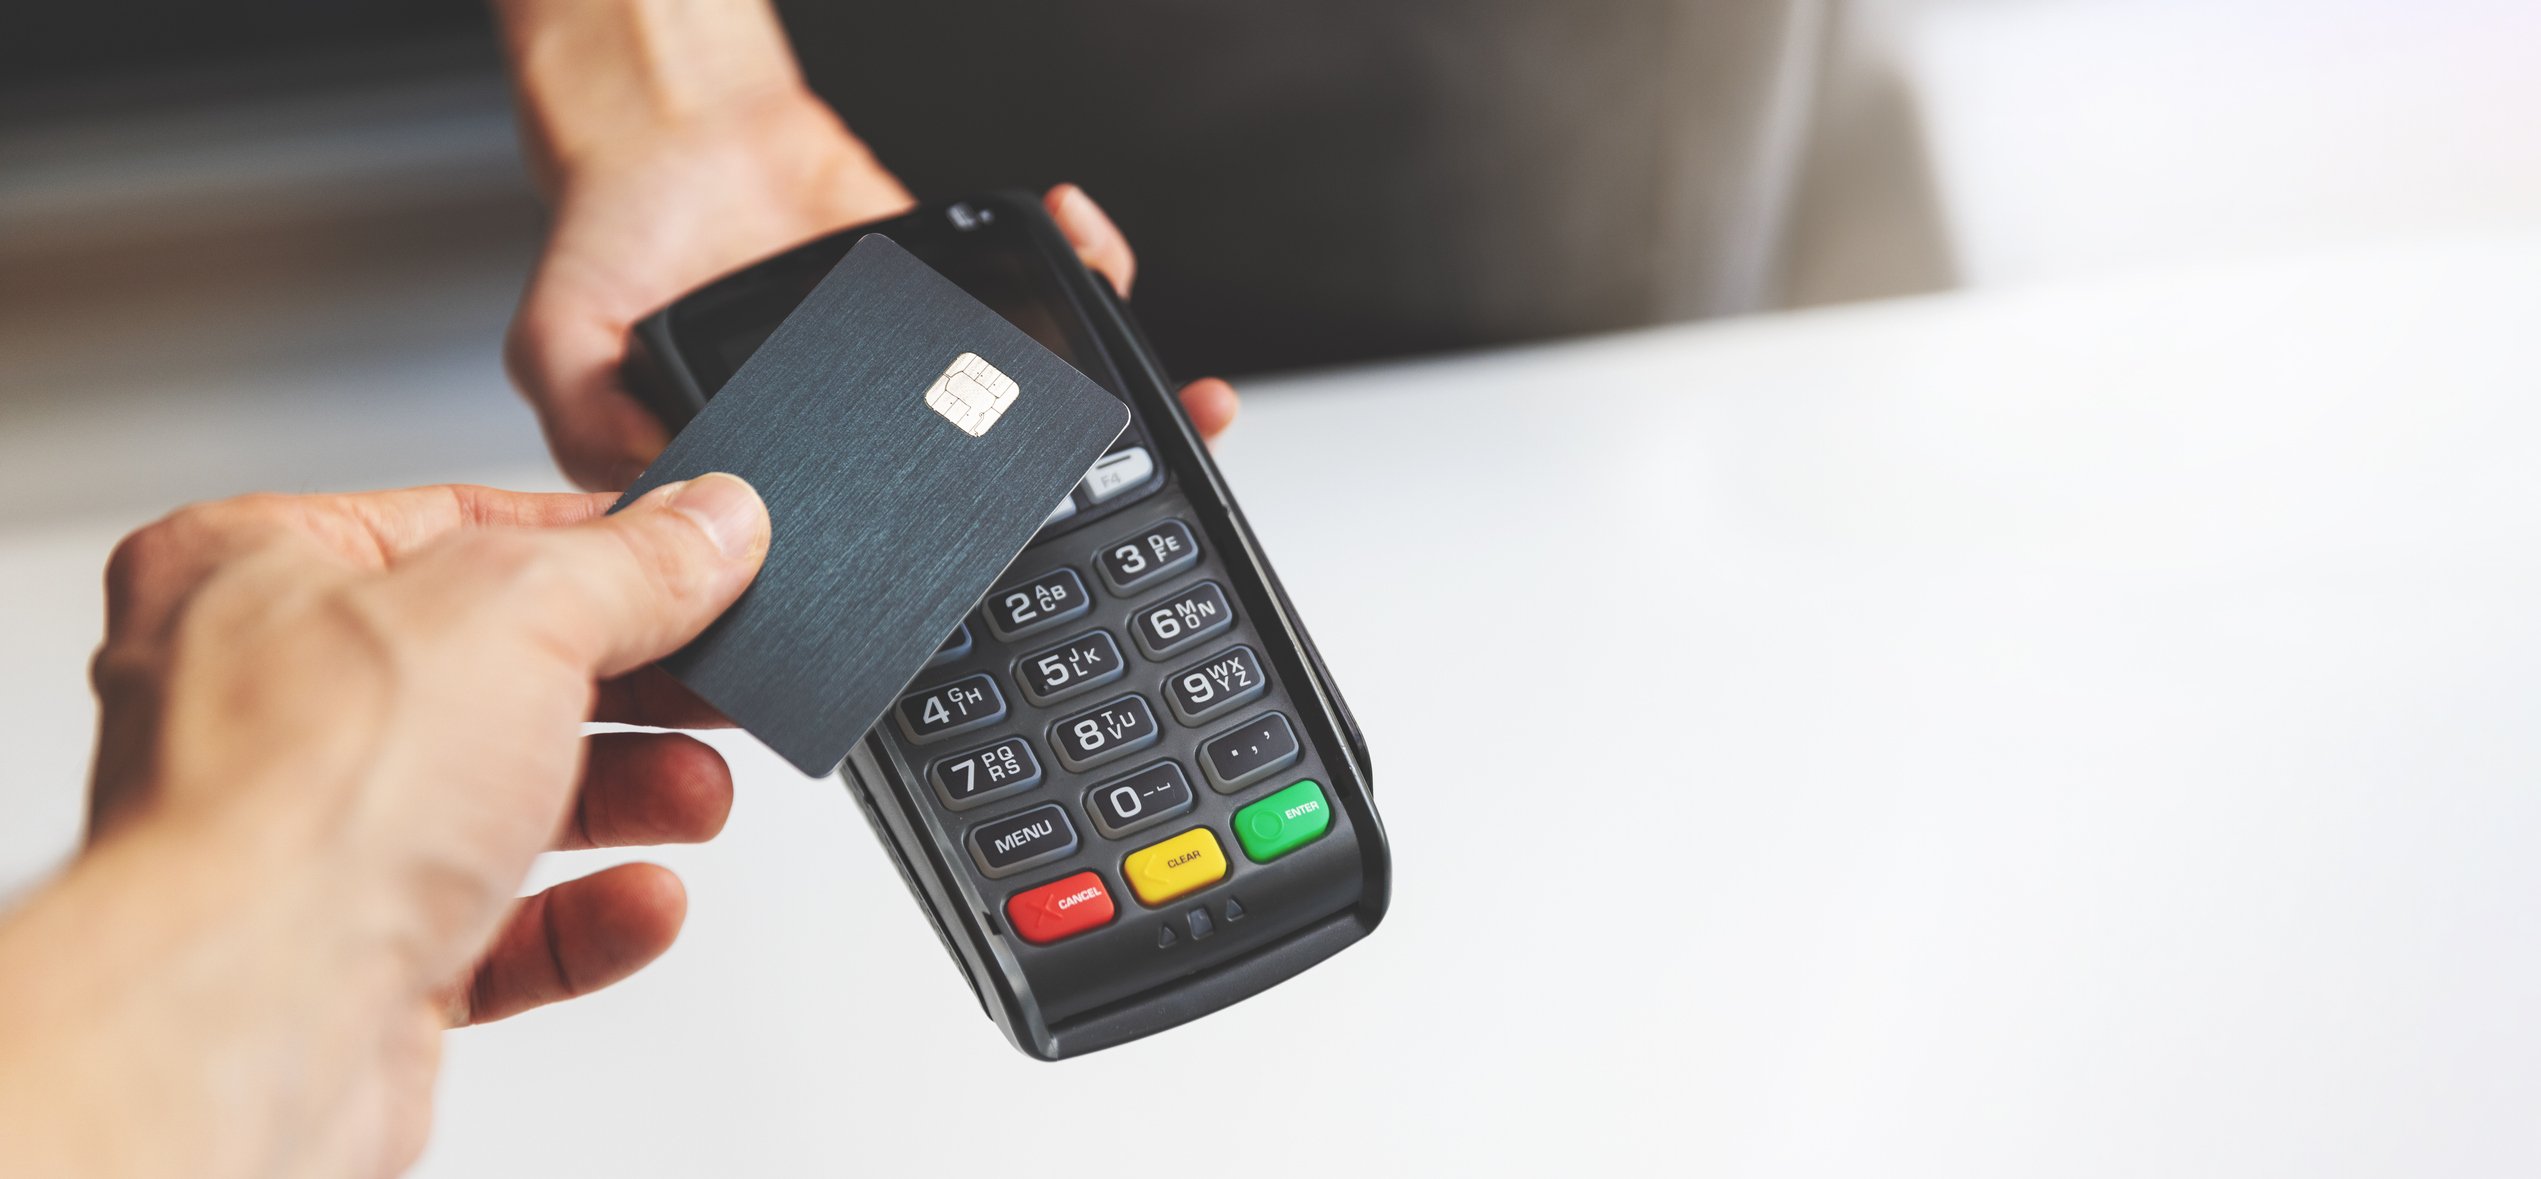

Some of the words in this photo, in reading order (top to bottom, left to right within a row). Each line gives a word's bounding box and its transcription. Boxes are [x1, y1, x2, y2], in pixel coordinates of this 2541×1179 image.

[1101, 473, 1121, 488] F4
[1116, 545, 1147, 574] 3
[1005, 593, 1037, 624] 2
[1151, 608, 1181, 639] 6
[1038, 655, 1070, 686] 5
[1184, 673, 1215, 704] 9
[923, 696, 950, 724] 4
[1074, 719, 1106, 751] 8
[950, 758, 975, 792] 7
[1285, 801, 1320, 820] ENTER
[995, 819, 1053, 855] MENU
[1168, 849, 1202, 870] CLEAR
[1058, 886, 1102, 911] CANCEL
